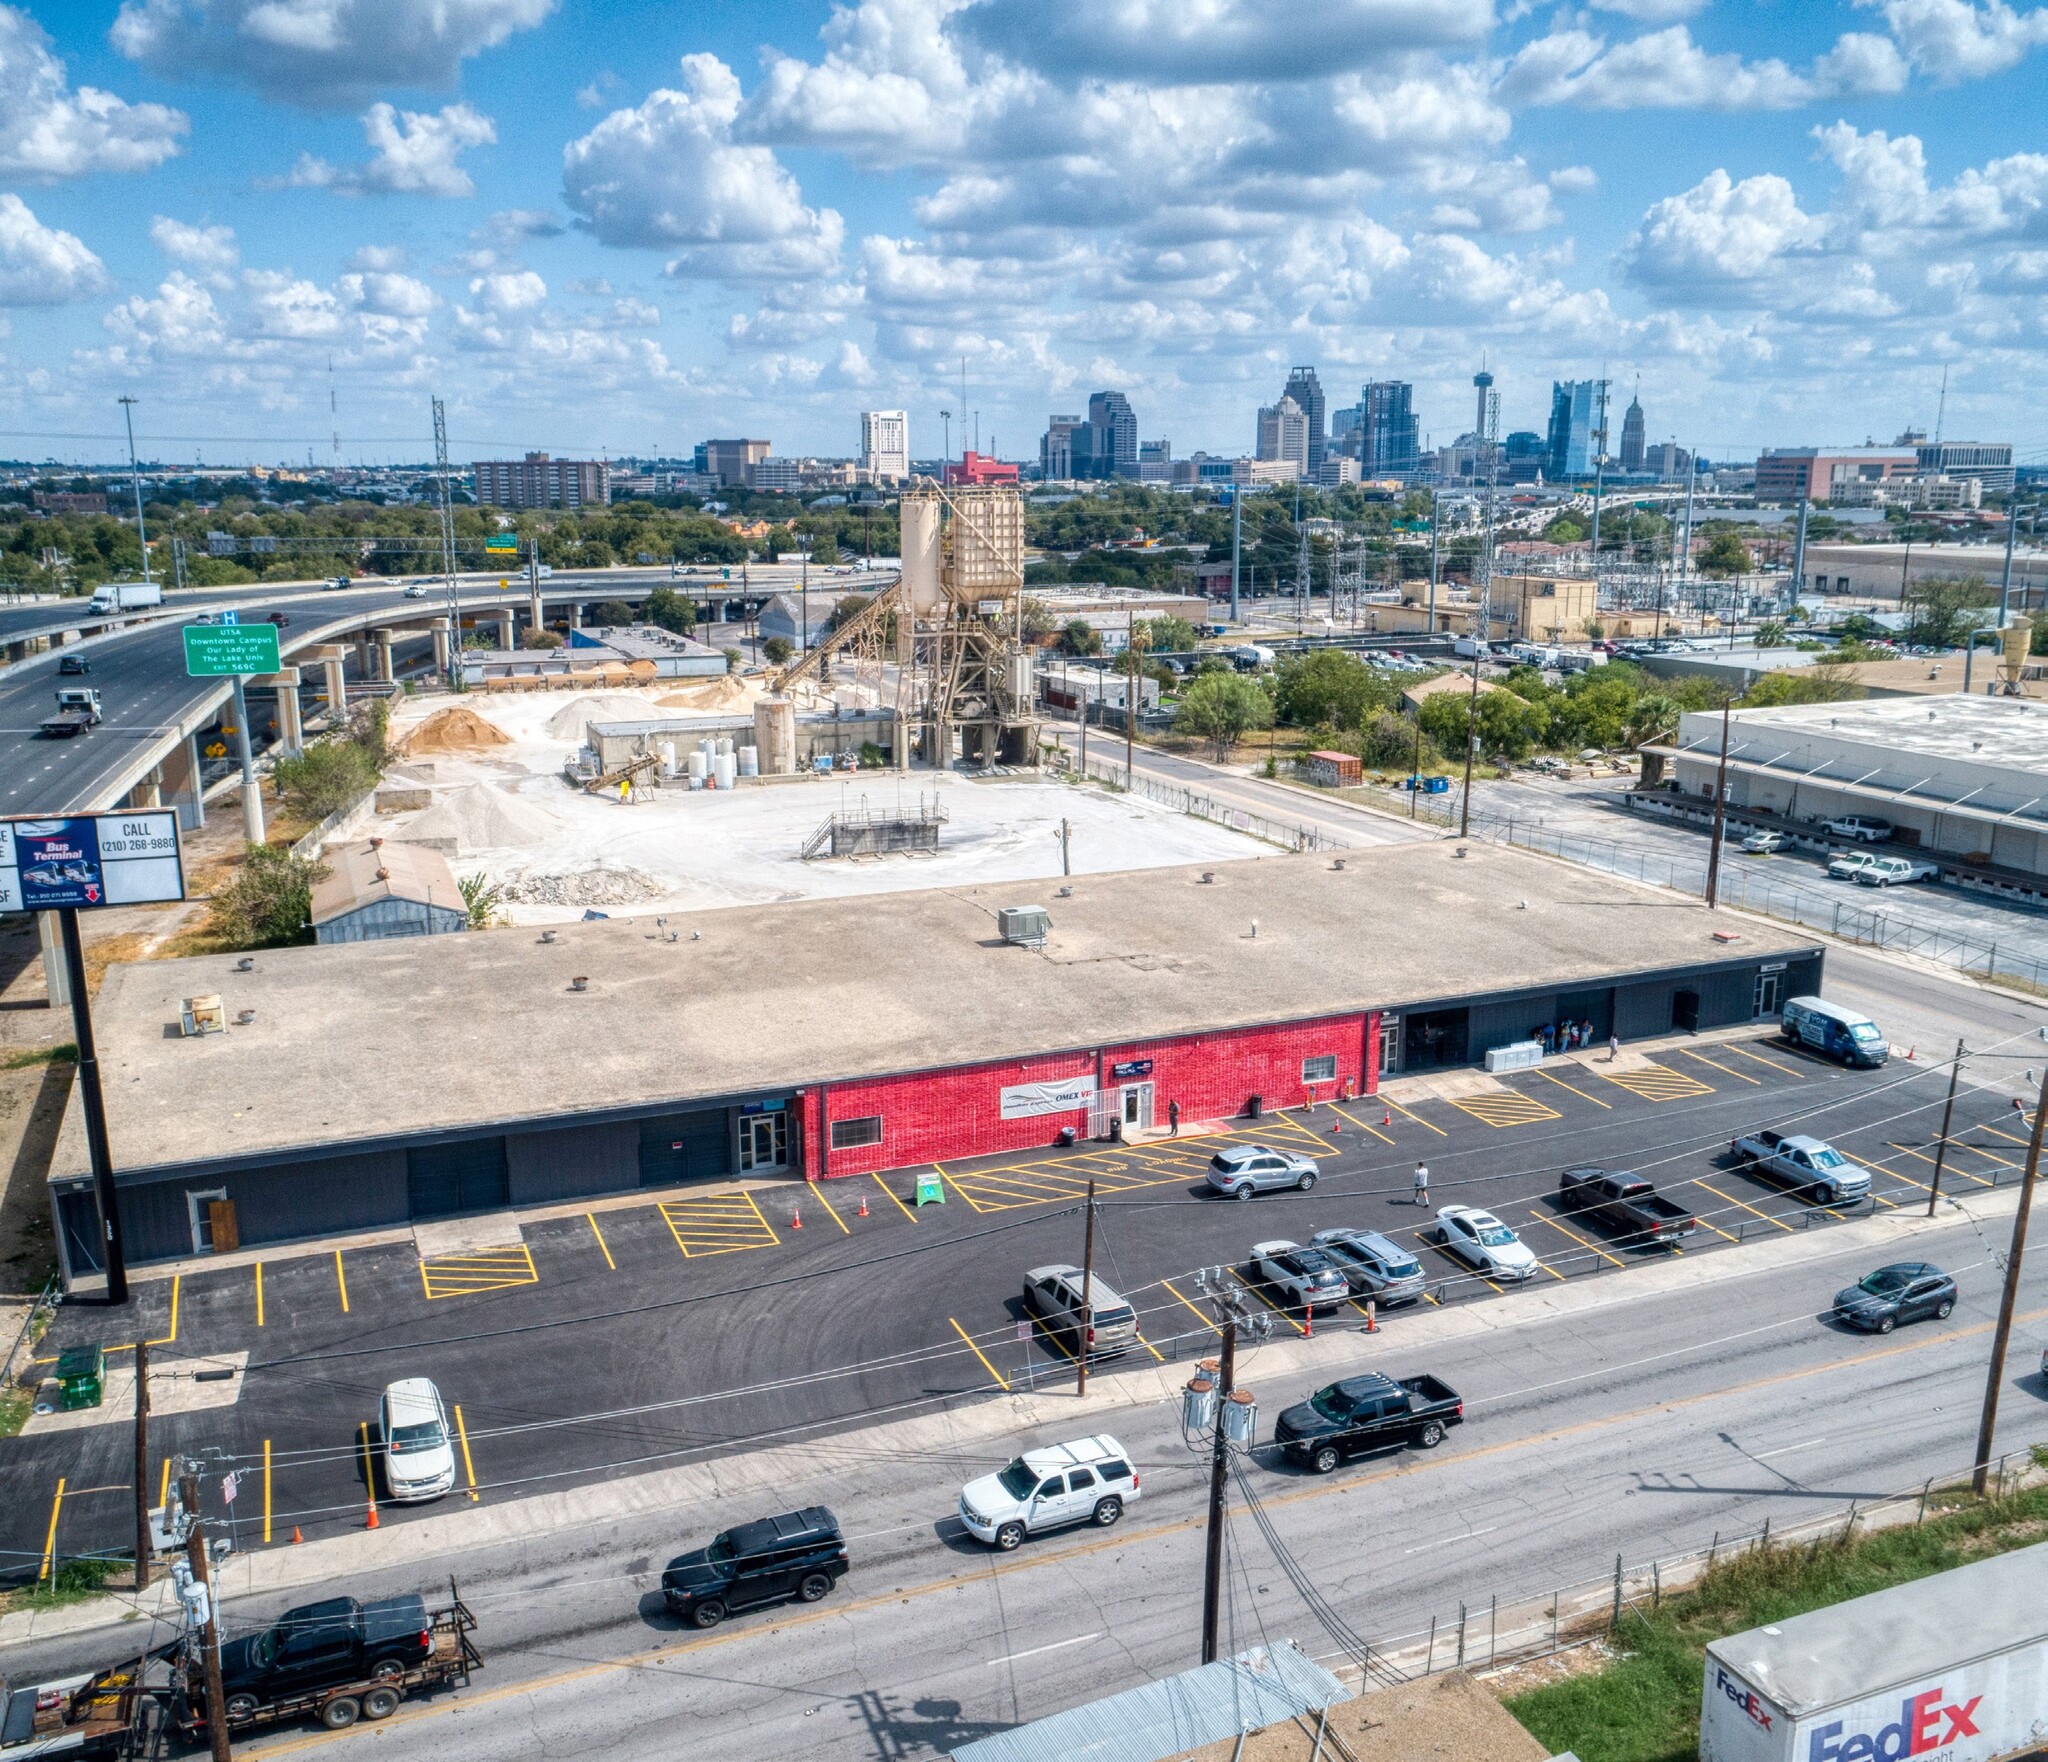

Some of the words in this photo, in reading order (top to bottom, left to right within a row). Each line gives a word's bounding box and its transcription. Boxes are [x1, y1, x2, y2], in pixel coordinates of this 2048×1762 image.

[223, 612, 236, 625] H
[239, 637, 272, 645] Campus
[226, 646, 245, 654] Lady
[232, 663, 256, 671] 569C
[122, 823, 151, 837] CALL
[46, 842, 70, 852] Bus
[102, 840, 127, 852] (210)
[130, 838, 176, 851] 268-9880
[33, 850, 83, 861] Terminal
[1055, 1091, 1079, 1102] OMEX
[1145, 1156, 1188, 1167] LOADING
[1717, 1667, 1772, 1733] FedEx
[1809, 1687, 1984, 1762] FedEx
